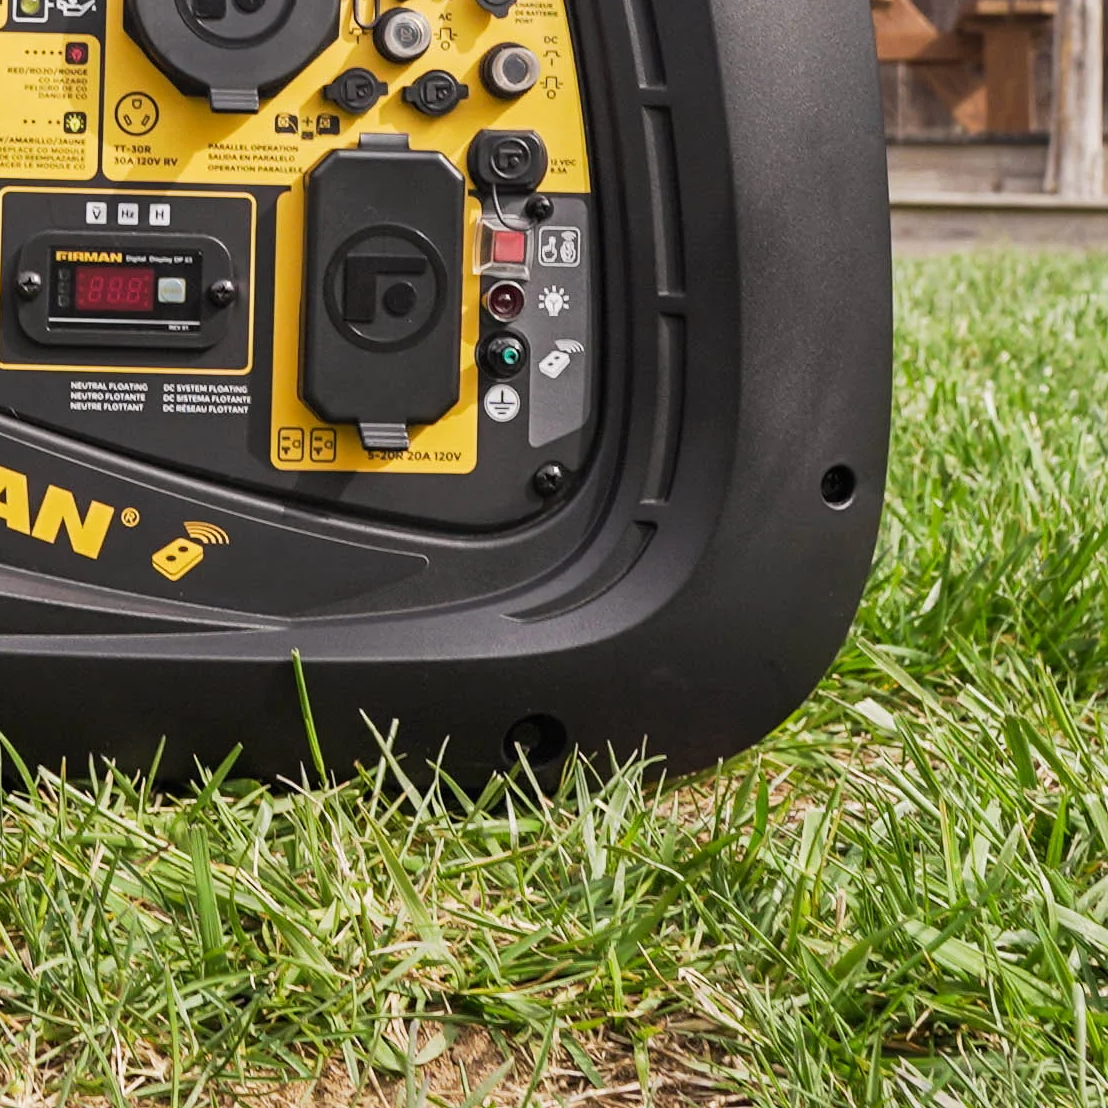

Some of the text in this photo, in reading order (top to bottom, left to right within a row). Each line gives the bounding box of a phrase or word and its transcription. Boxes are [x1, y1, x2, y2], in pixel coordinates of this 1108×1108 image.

[438, 13, 452, 21] AC
[544, 36, 558, 44] DC
[114, 145, 151, 154] TT-30R
[208, 144, 299, 153] PARALLEL OPERATION
[114, 157, 178, 166] 30A 120V RV
[121, 209, 135, 219] Hz
[155, 210, 165, 220] H
[55, 250, 123, 263] FIRMAN
[70, 381, 148, 391] NEUTRAL FLOATING
[163, 383, 248, 393] DC SYSTEM FLOATING
[70, 392, 145, 401] NEUTRO FLOTANTE
[163, 393, 175, 402] DC
[212, 395, 251, 404] FLOTANTE
[70, 402, 143, 411] NEUTRE FLOTTANT
[163, 404, 175, 413] DC
[208, 405, 248, 414] FLOTTANT
[407, 452, 431, 461] 20A
[434, 452, 461, 461] 120V
